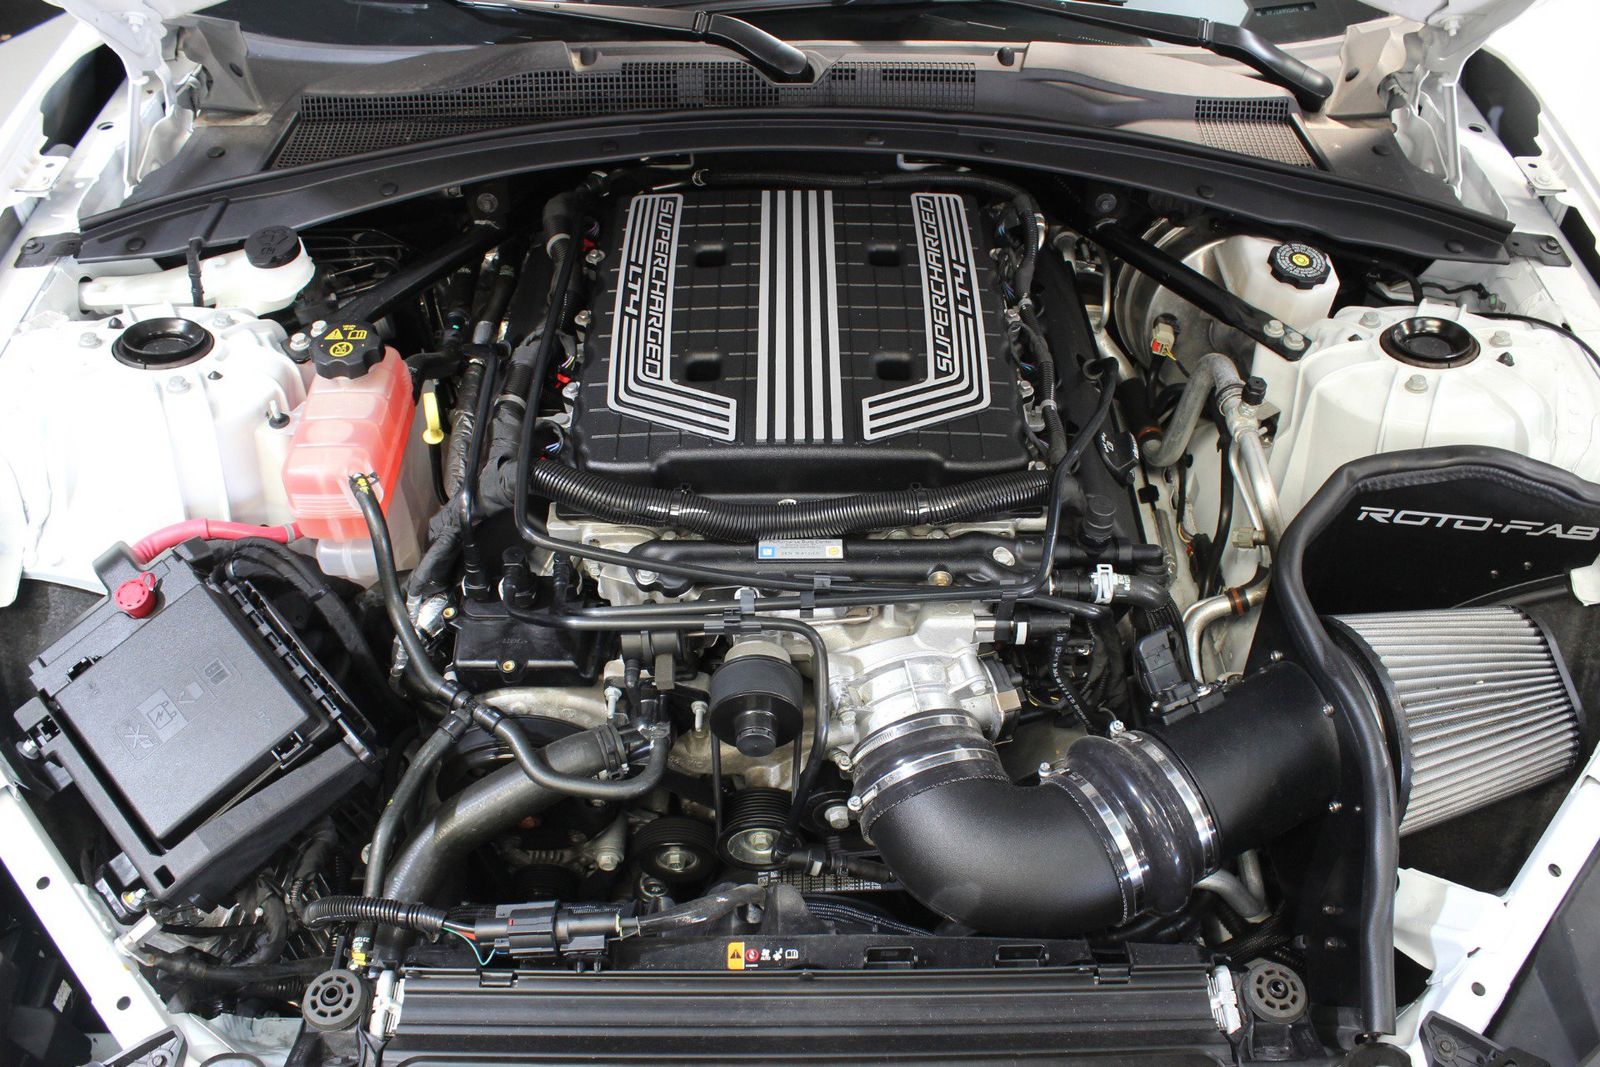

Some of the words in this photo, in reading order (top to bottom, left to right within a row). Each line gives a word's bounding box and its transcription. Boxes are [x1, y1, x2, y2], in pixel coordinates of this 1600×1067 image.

[624, 263, 643, 317] LT4
[645, 198, 675, 380] SUPERCHARGED
[917, 197, 954, 373] SUPERCHARGED
[952, 262, 974, 315] LT4
[1357, 506, 1600, 540] ROTO-FAB
